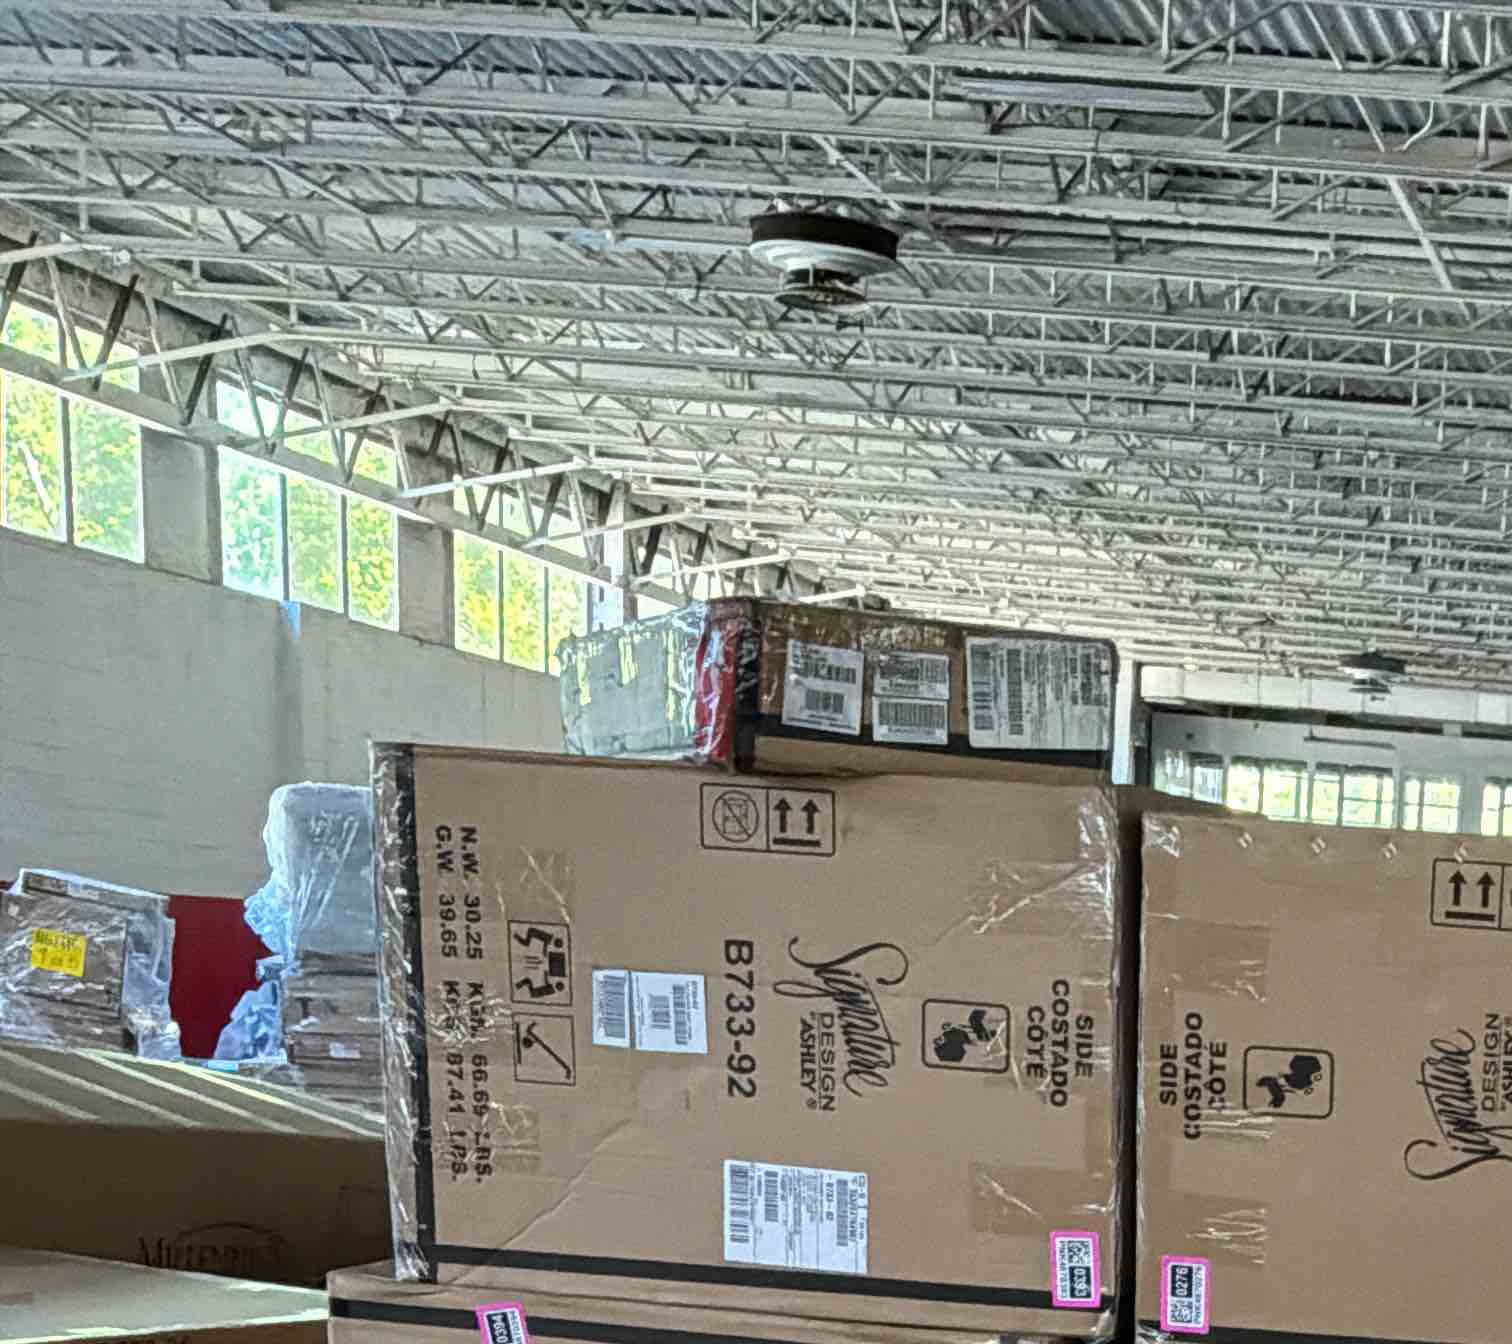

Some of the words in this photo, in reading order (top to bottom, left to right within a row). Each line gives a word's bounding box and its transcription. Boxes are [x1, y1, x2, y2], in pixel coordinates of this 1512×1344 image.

[437, 894, 458, 958] 39.65
[463, 895, 483, 959] 30.25
[724, 938, 757, 1099] B733-92
[773, 936, 909, 1097] Signature
[1050, 979, 1070, 1108] COSTADO
[1075, 1013, 1094, 1079] SIDE
[446, 1053, 466, 1113] 87.41
[820, 1012, 836, 1112] DESIGN
[1159, 1042, 1178, 1106] SIDE
[1184, 1011, 1202, 1140] COSTADO
[1481, 1013, 1500, 1112] DESIGN
[1175, 1267, 1189, 1297] 0276
[491, 1314, 509, 1344] 0394
